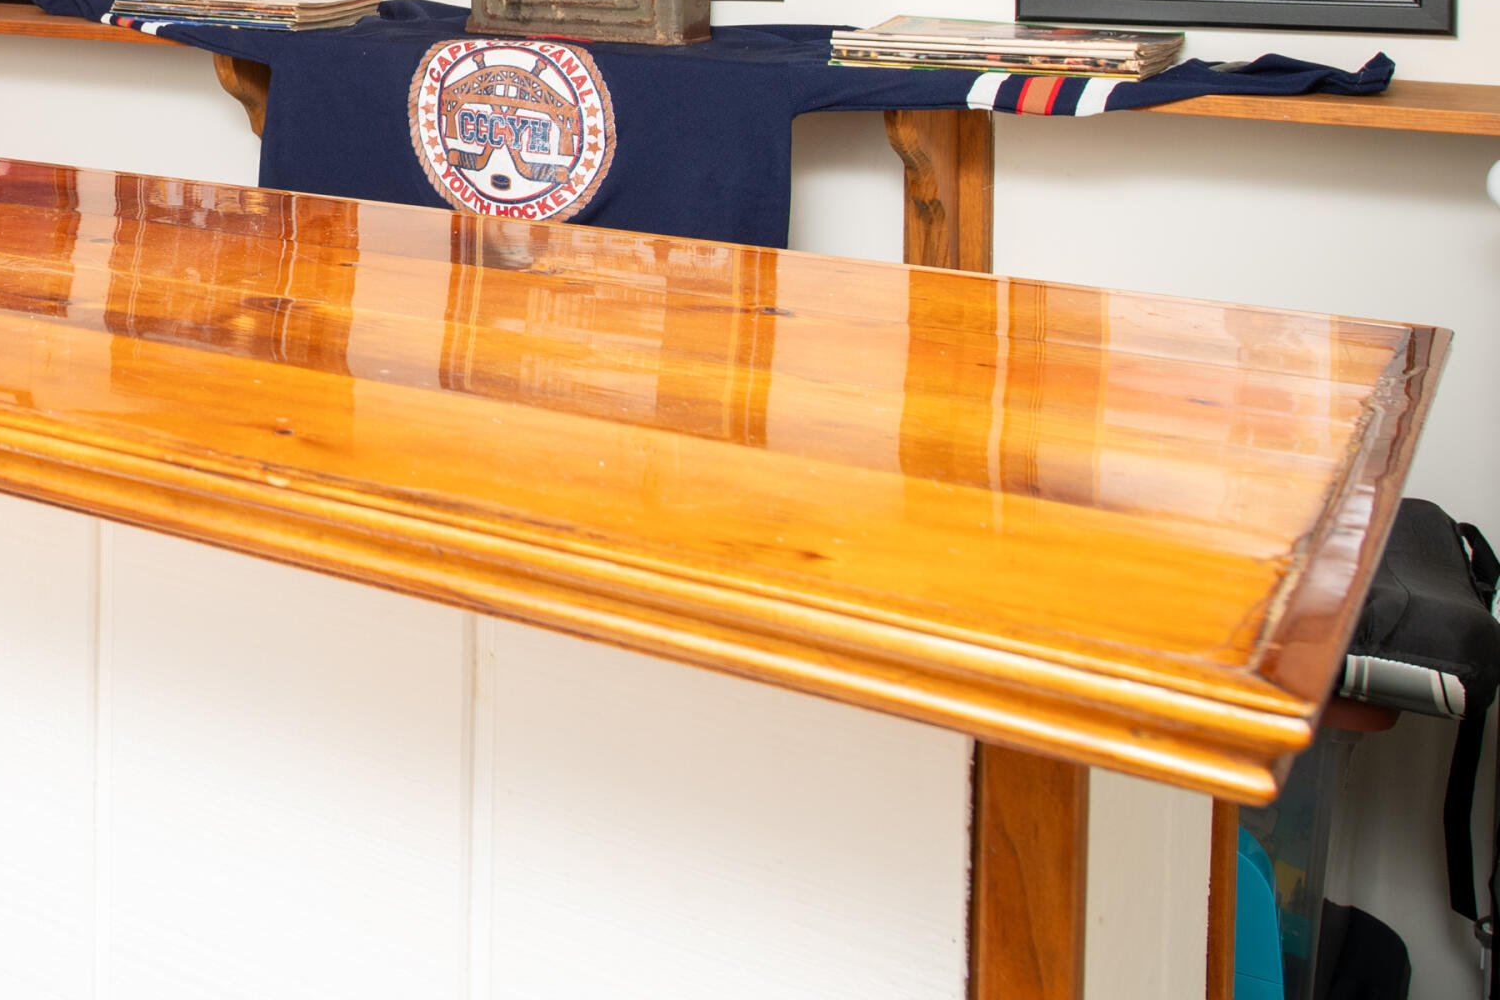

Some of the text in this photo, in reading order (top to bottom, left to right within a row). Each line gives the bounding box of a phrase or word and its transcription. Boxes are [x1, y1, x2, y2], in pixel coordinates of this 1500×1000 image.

[429, 41, 476, 83] CAPE
[539, 44, 594, 103] CANAL
[458, 109, 551, 154] CCCYH
[441, 166, 577, 220] YOUTH HOCKEY
